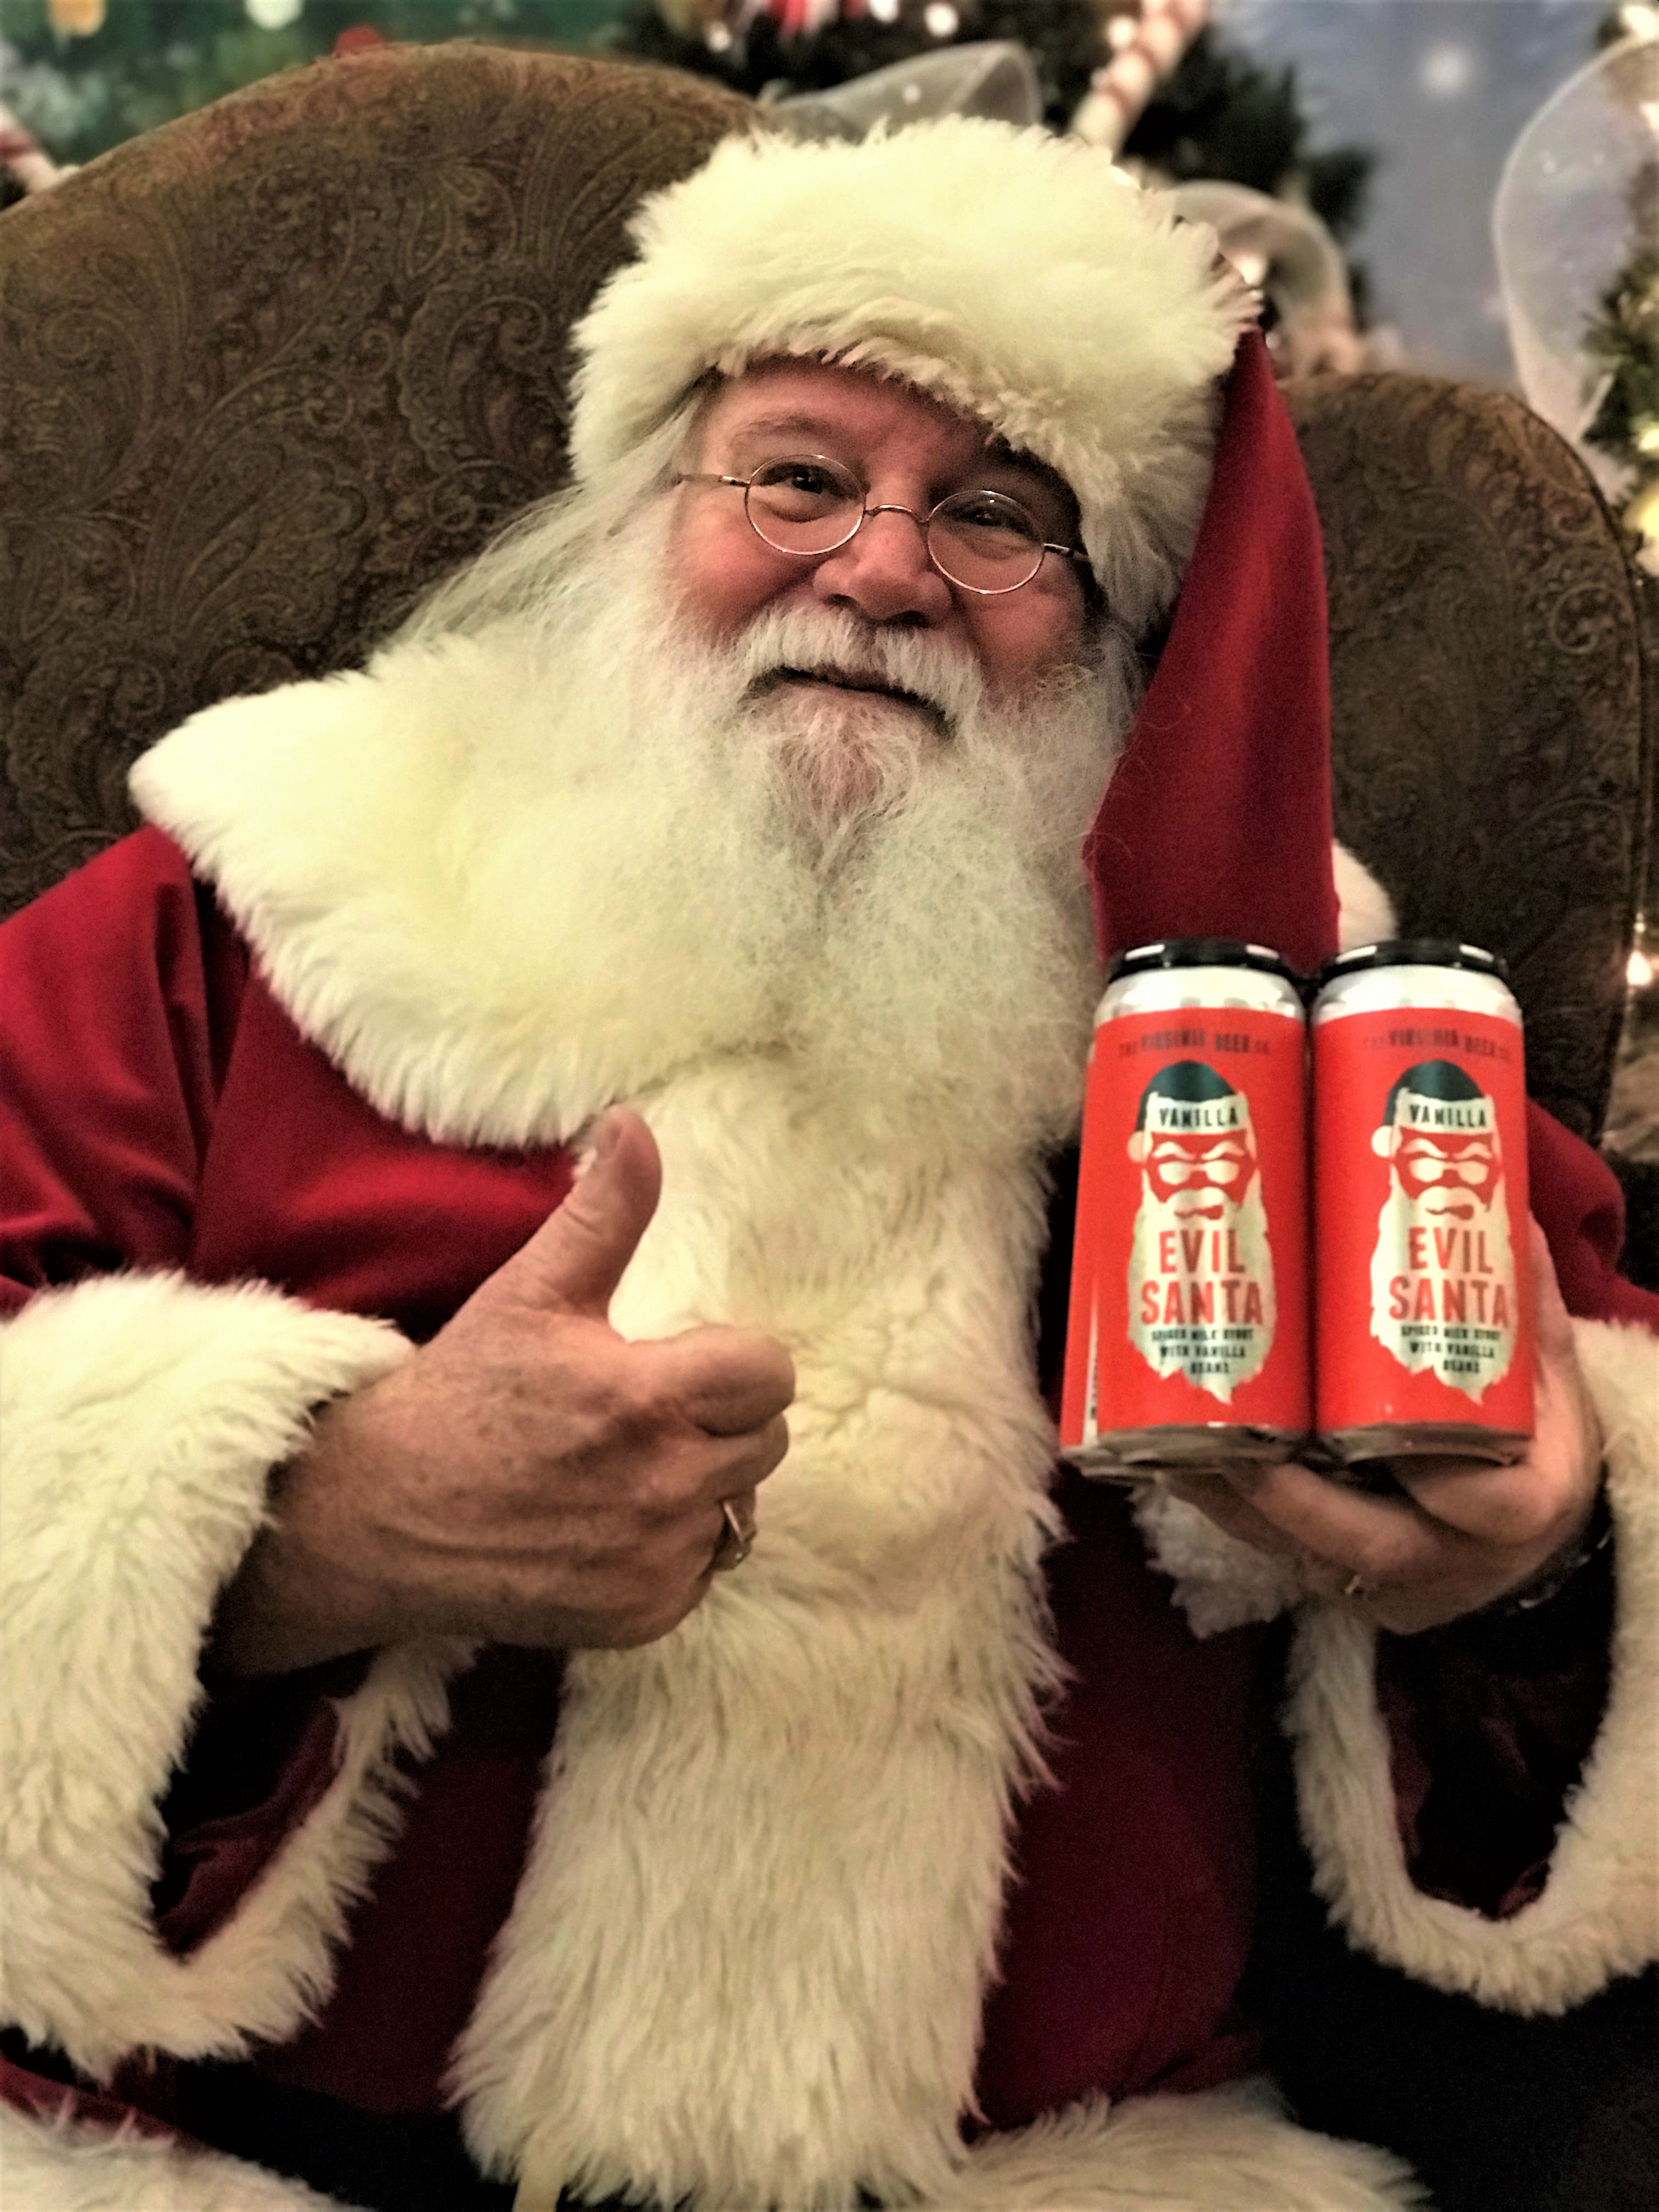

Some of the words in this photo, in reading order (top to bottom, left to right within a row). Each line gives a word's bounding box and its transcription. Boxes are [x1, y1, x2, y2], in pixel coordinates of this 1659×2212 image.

[1159, 1107, 1238, 1126] VANILLA
[1409, 1104, 1486, 1127] VANILLA
[1159, 1229, 1245, 1273] EVIL
[1408, 1227, 1493, 1273] EVIL
[1141, 1280, 1263, 1325] SANTA
[1389, 1276, 1509, 1327] SANTA
[1195, 1346, 1245, 1358] VANILLA
[1447, 1344, 1494, 1358] VANILLA
